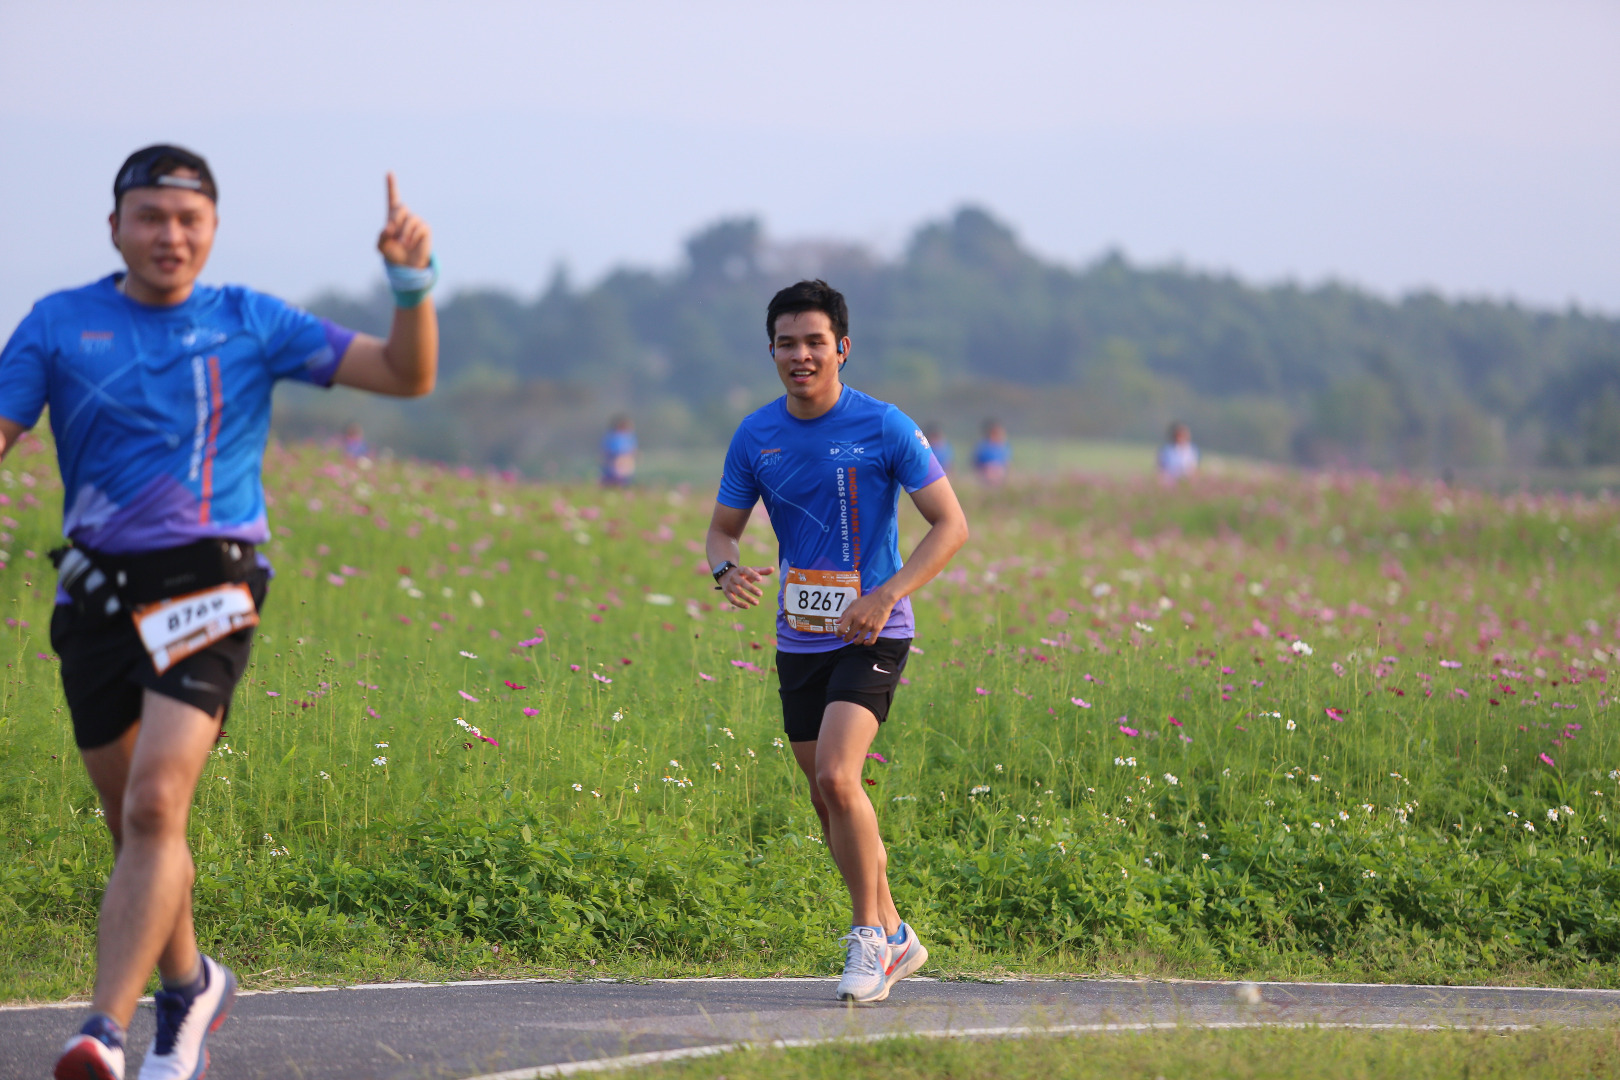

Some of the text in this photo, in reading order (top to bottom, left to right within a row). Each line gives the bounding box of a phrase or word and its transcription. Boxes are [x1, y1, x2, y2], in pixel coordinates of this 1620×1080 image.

[836, 467, 846, 497] CROSS
[847, 467, 858, 506] SINGHA
[839, 499, 849, 541] COUNTRY
[850, 508, 860, 534] PARK
[842, 543, 850, 562] RUN
[798, 590, 845, 613] 8267
